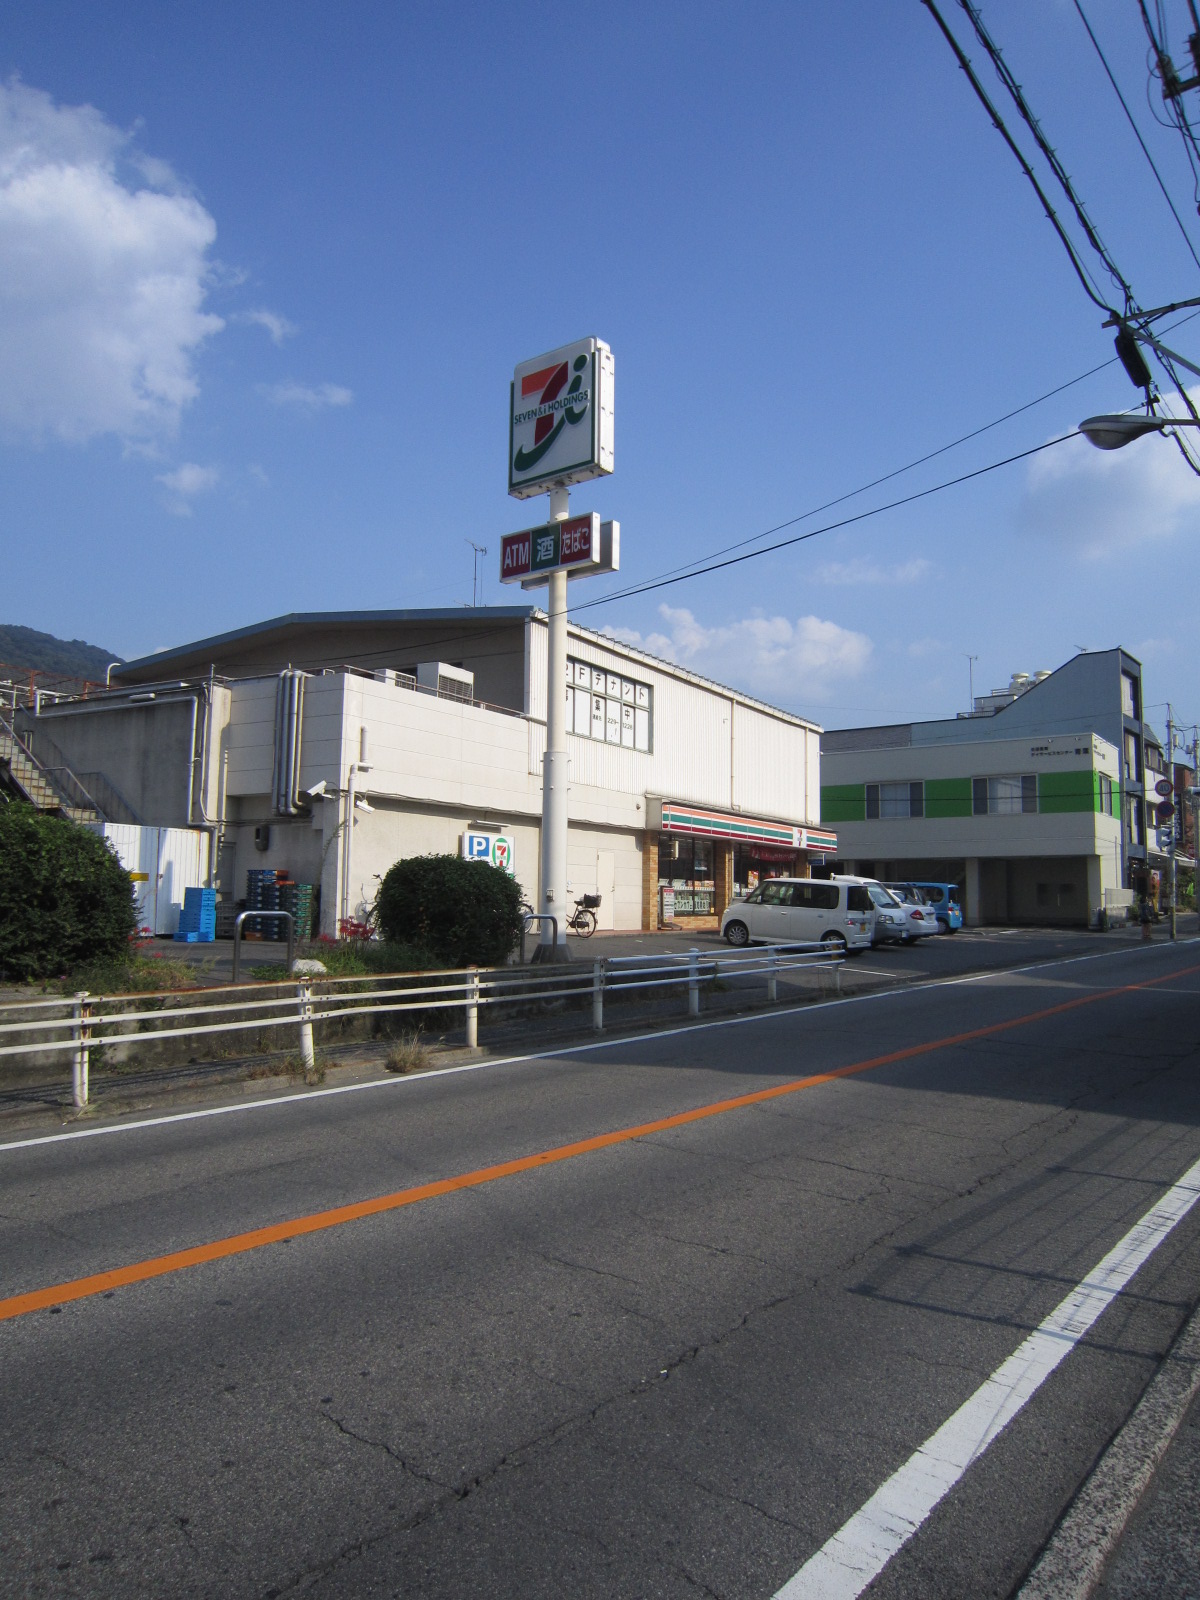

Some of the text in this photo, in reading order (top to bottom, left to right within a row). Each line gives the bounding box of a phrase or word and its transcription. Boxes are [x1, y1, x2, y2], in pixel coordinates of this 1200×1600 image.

[548, 389, 589, 412] HOLDINGS
[504, 541, 529, 569] ATM
[536, 535, 555, 563] 酒
[561, 527, 590, 556] たばこ
[472, 837, 487, 855] P
